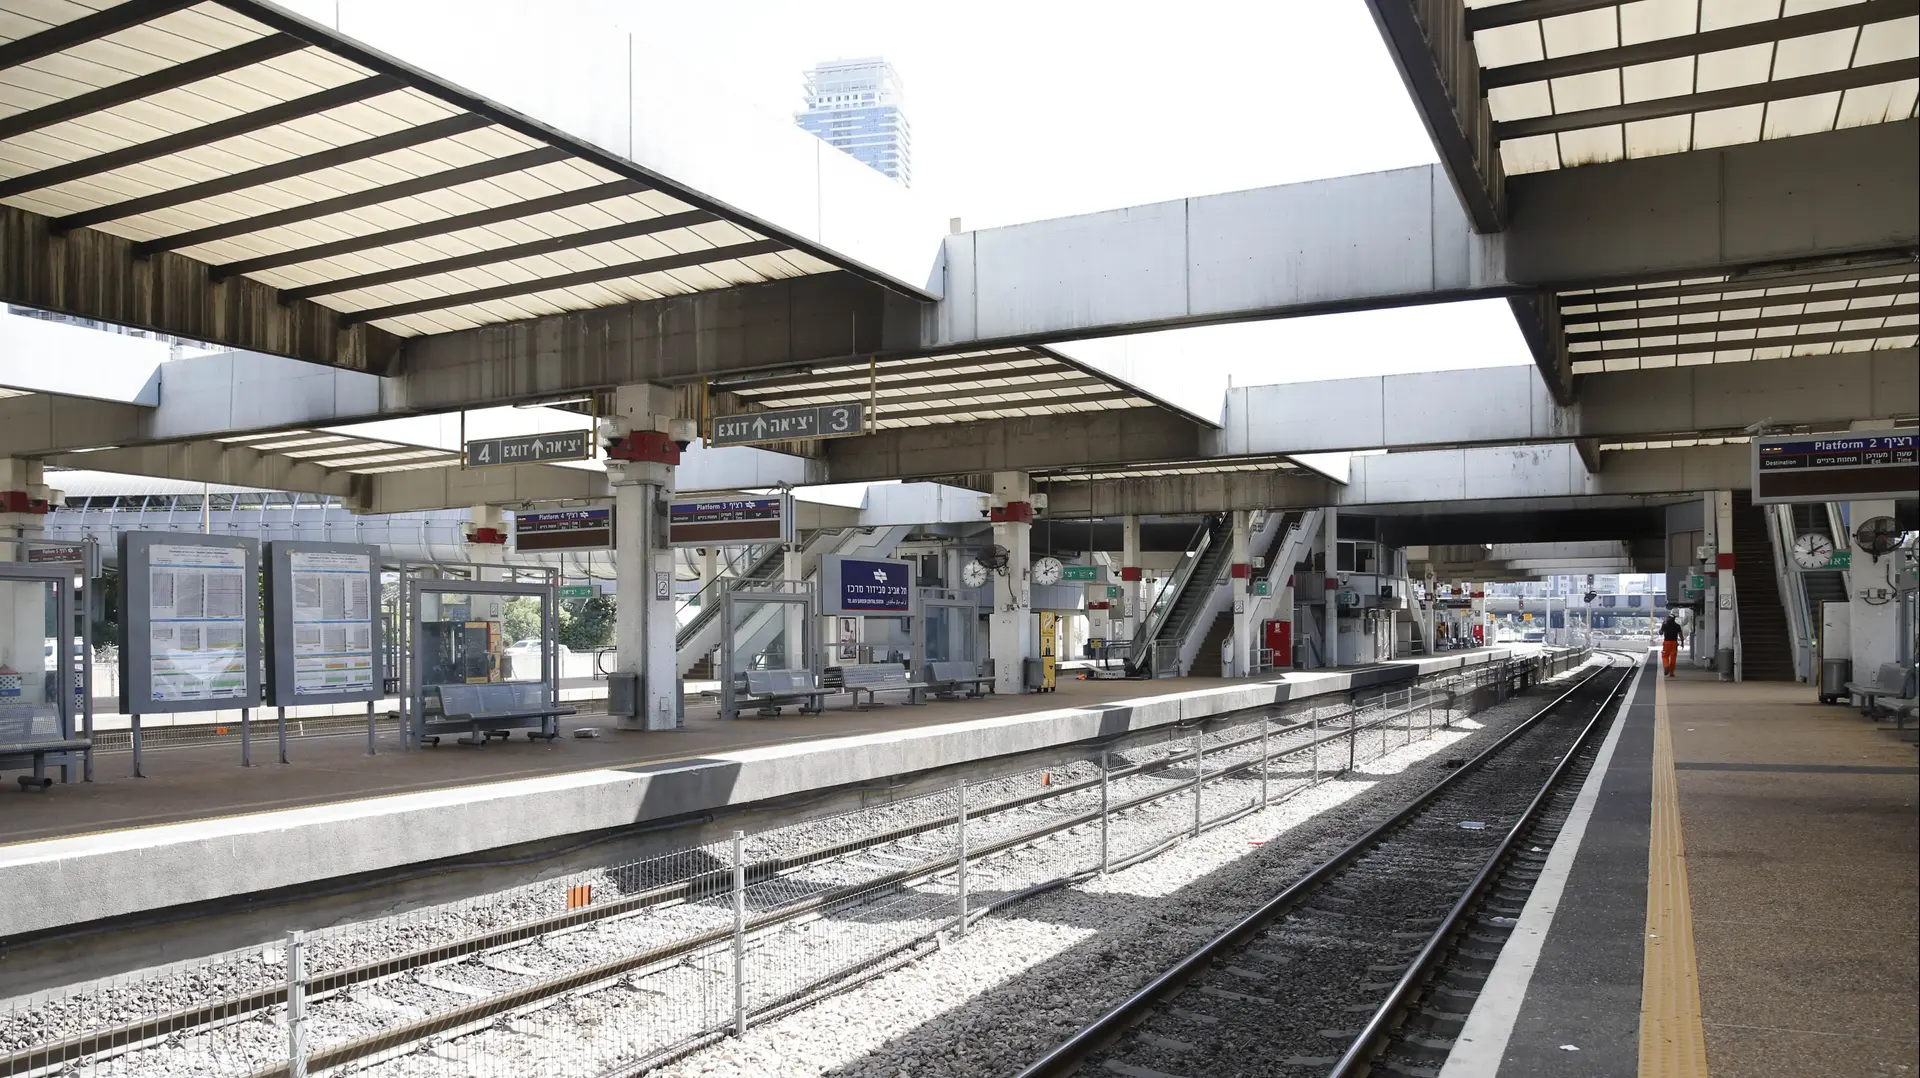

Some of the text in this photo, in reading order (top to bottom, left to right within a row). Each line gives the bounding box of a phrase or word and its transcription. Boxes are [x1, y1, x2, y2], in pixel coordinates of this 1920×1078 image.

[770, 416, 812, 432] יציאה
[832, 408, 848, 431] 3
[718, 422, 748, 436] EXIT
[546, 439, 581, 453] יציאה
[1815, 438, 1877, 450] Platform 2
[1884, 437, 1912, 448] רציף
[478, 444, 490, 463] 4
[504, 444, 529, 458] EXIT
[729, 502, 742, 510] רציף
